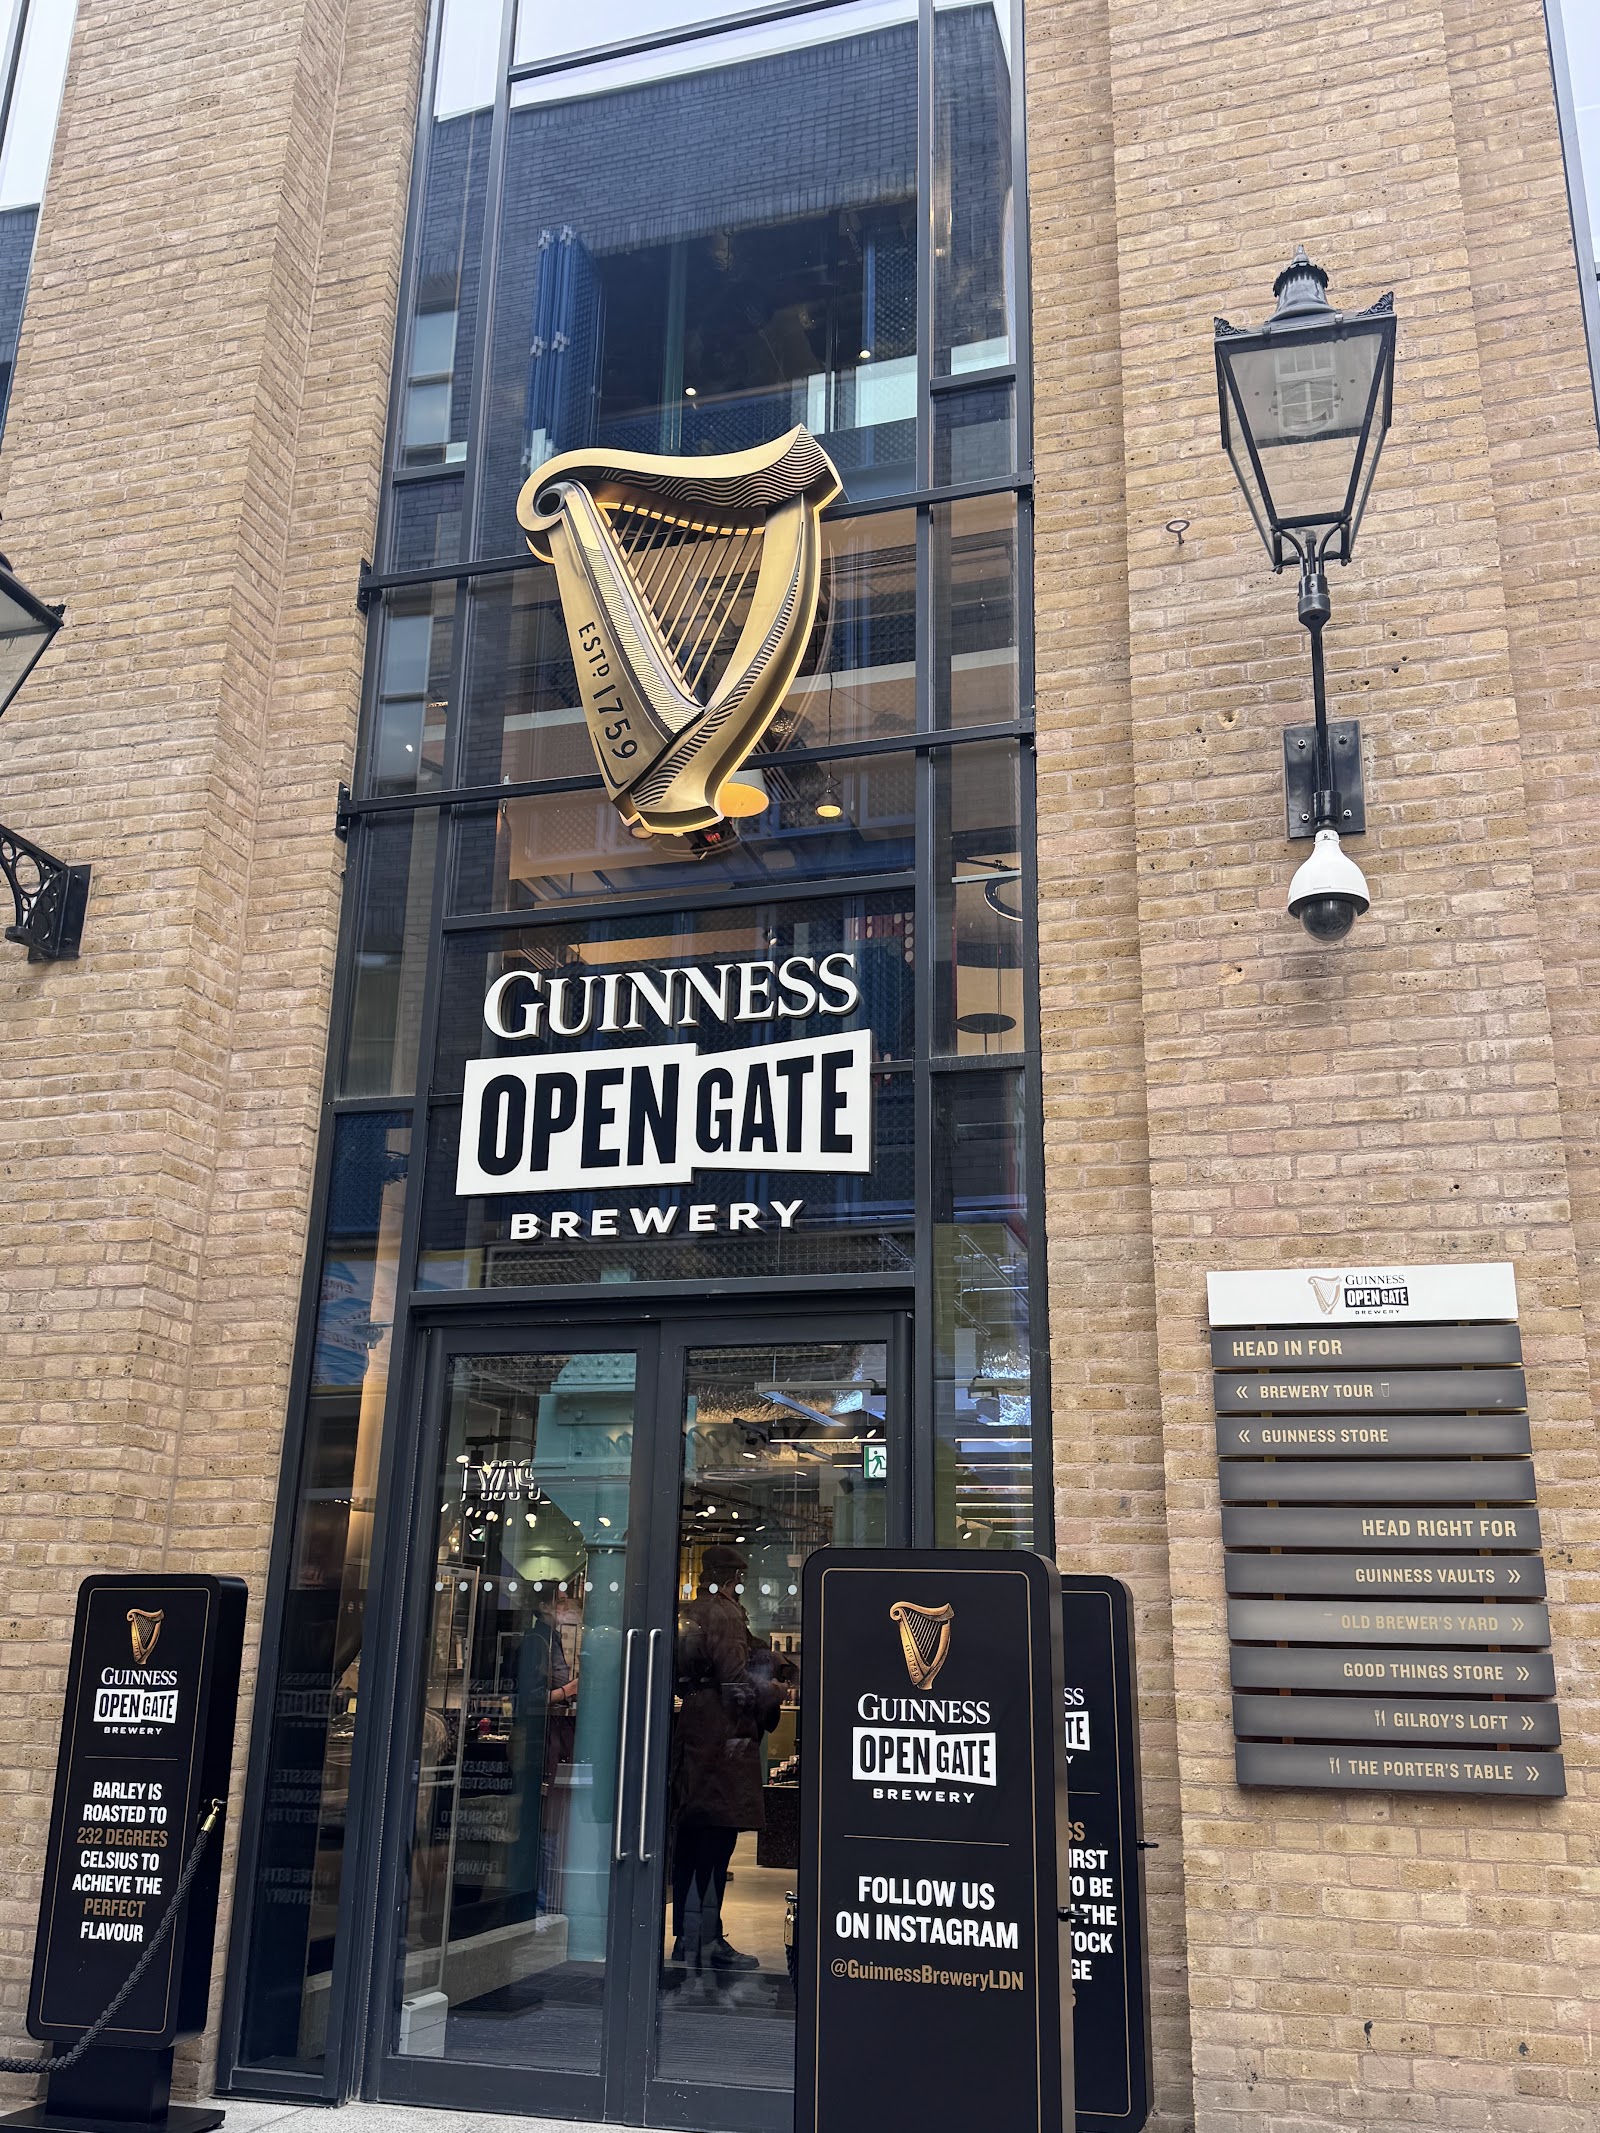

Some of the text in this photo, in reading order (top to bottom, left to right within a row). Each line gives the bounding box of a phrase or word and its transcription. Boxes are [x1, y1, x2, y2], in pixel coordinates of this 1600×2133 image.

[592, 684, 638, 759] 1759
[483, 953, 857, 1039] GUINNESS
[477, 1049, 854, 1176] OPEN GATE
[509, 1200, 803, 1240] BREWERY
[1345, 1274, 1405, 1286] GUINNESS
[1346, 1288, 1408, 1306] OPEN GATE
[1233, 1339, 1343, 1357] HEAD IN FOR
[1259, 1384, 1374, 1399] BREWERY TOUR
[1261, 1429, 1389, 1443] GUINNESS STORE
[1362, 1519, 1517, 1537] HEAD RIGHT FOR
[1355, 1568, 1495, 1583] GUINNESS VAULTS
[1341, 1614, 1499, 1631] OLD BREWER'S YARD
[100, 1666, 178, 1686] GUINNESS
[1343, 1662, 1504, 1680] GOOD THINGS STORE
[98, 1693, 173, 1720] OPEN GATE
[857, 1692, 991, 1726] GUINNESS
[103, 1725, 162, 1735] BREWERY
[1065, 1717, 1085, 1745] TE
[1393, 1712, 1508, 1730] GILROY'S LOFT
[859, 1733, 991, 1779] OPEN GATE
[1348, 1759, 1513, 1780] THE PORTER'S TABLE
[93, 1781, 162, 1800] BARLEY IS
[872, 1788, 976, 1804] BREWERY
[82, 1805, 167, 1825] ROASTED TO
[76, 1827, 169, 1848] 232 DEGREES
[80, 1851, 160, 1871] CELSIUS TO
[1069, 1849, 1109, 1870] IRST
[71, 1874, 162, 1895] ACHIEVE THE
[857, 1876, 995, 1910] FOLLOW US
[1069, 1876, 1114, 1898] O BE
[83, 1898, 146, 1918] PERFECT
[1080, 1904, 1117, 1926] THE
[80, 1921, 144, 1943] FLAVOUR
[835, 1910, 1018, 1950] ON INSTAGRAM
[1071, 1932, 1113, 1953] OCK
[830, 1957, 1024, 1991] @GuinnessBreweryLDN
